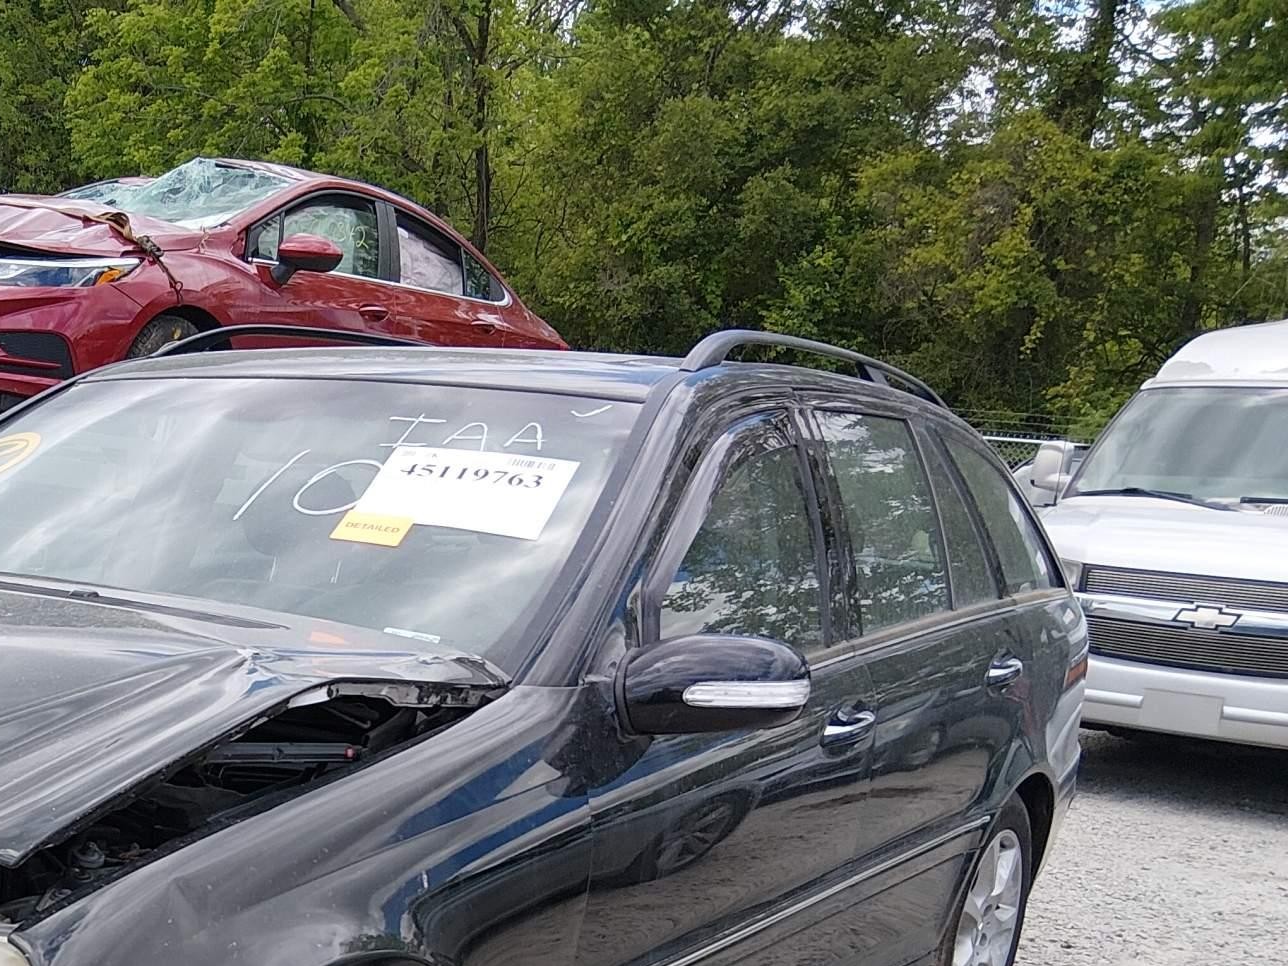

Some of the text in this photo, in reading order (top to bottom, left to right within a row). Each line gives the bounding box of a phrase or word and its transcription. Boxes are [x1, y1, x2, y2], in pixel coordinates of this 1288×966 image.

[379, 413, 548, 451] IAA
[399, 463, 544, 489] 45119763
[344, 521, 401, 534] DETAILED
